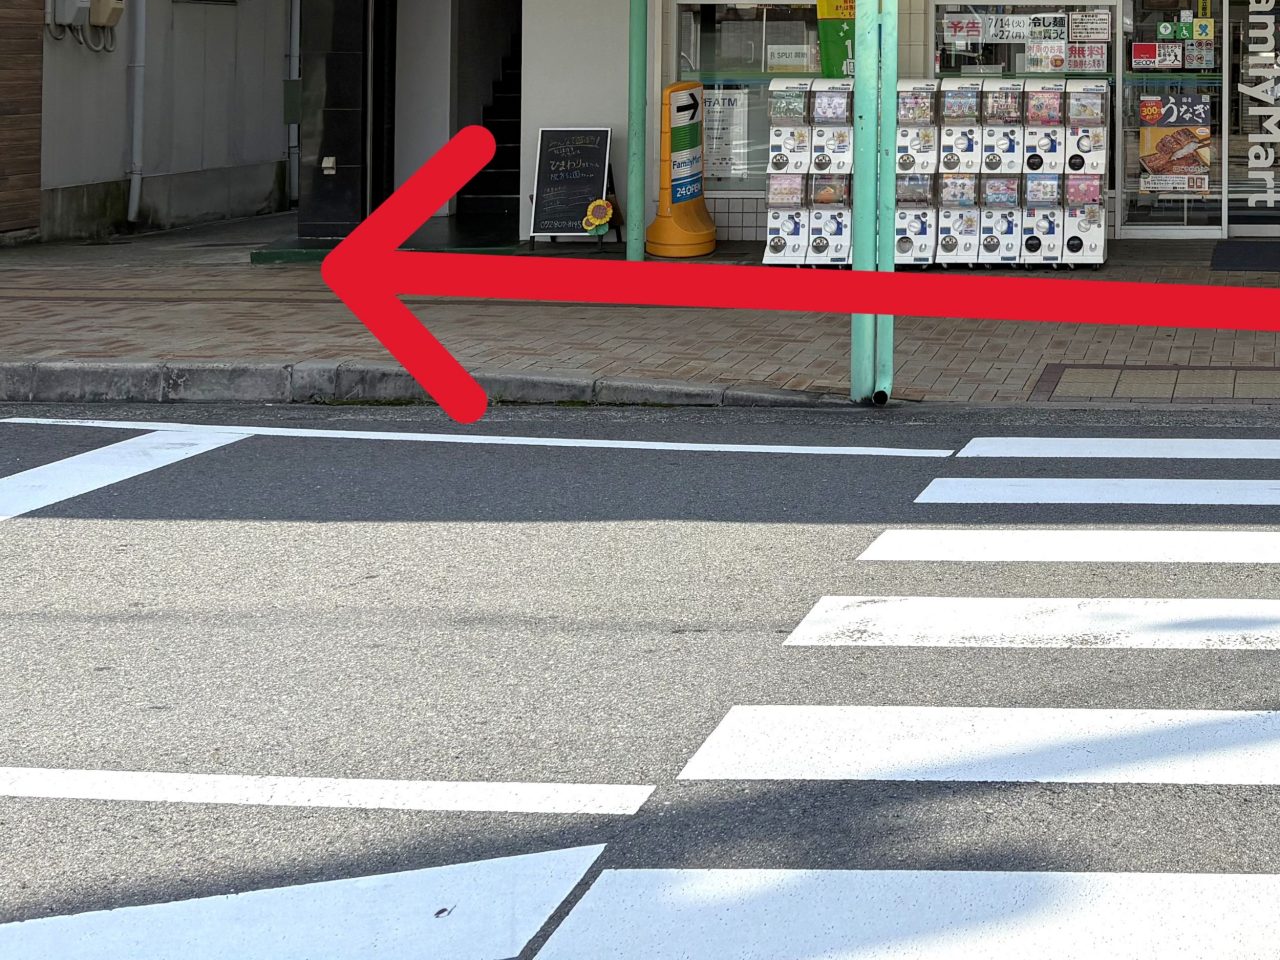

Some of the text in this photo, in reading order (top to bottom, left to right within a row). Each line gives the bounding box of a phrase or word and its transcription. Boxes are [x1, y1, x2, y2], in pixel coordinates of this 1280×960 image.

[947, 21, 982, 37] 予告
[1028, 16, 1066, 28] 冷し麺
[1068, 45, 1105, 58] 無料
[1161, 96, 1210, 125] うなぎ
